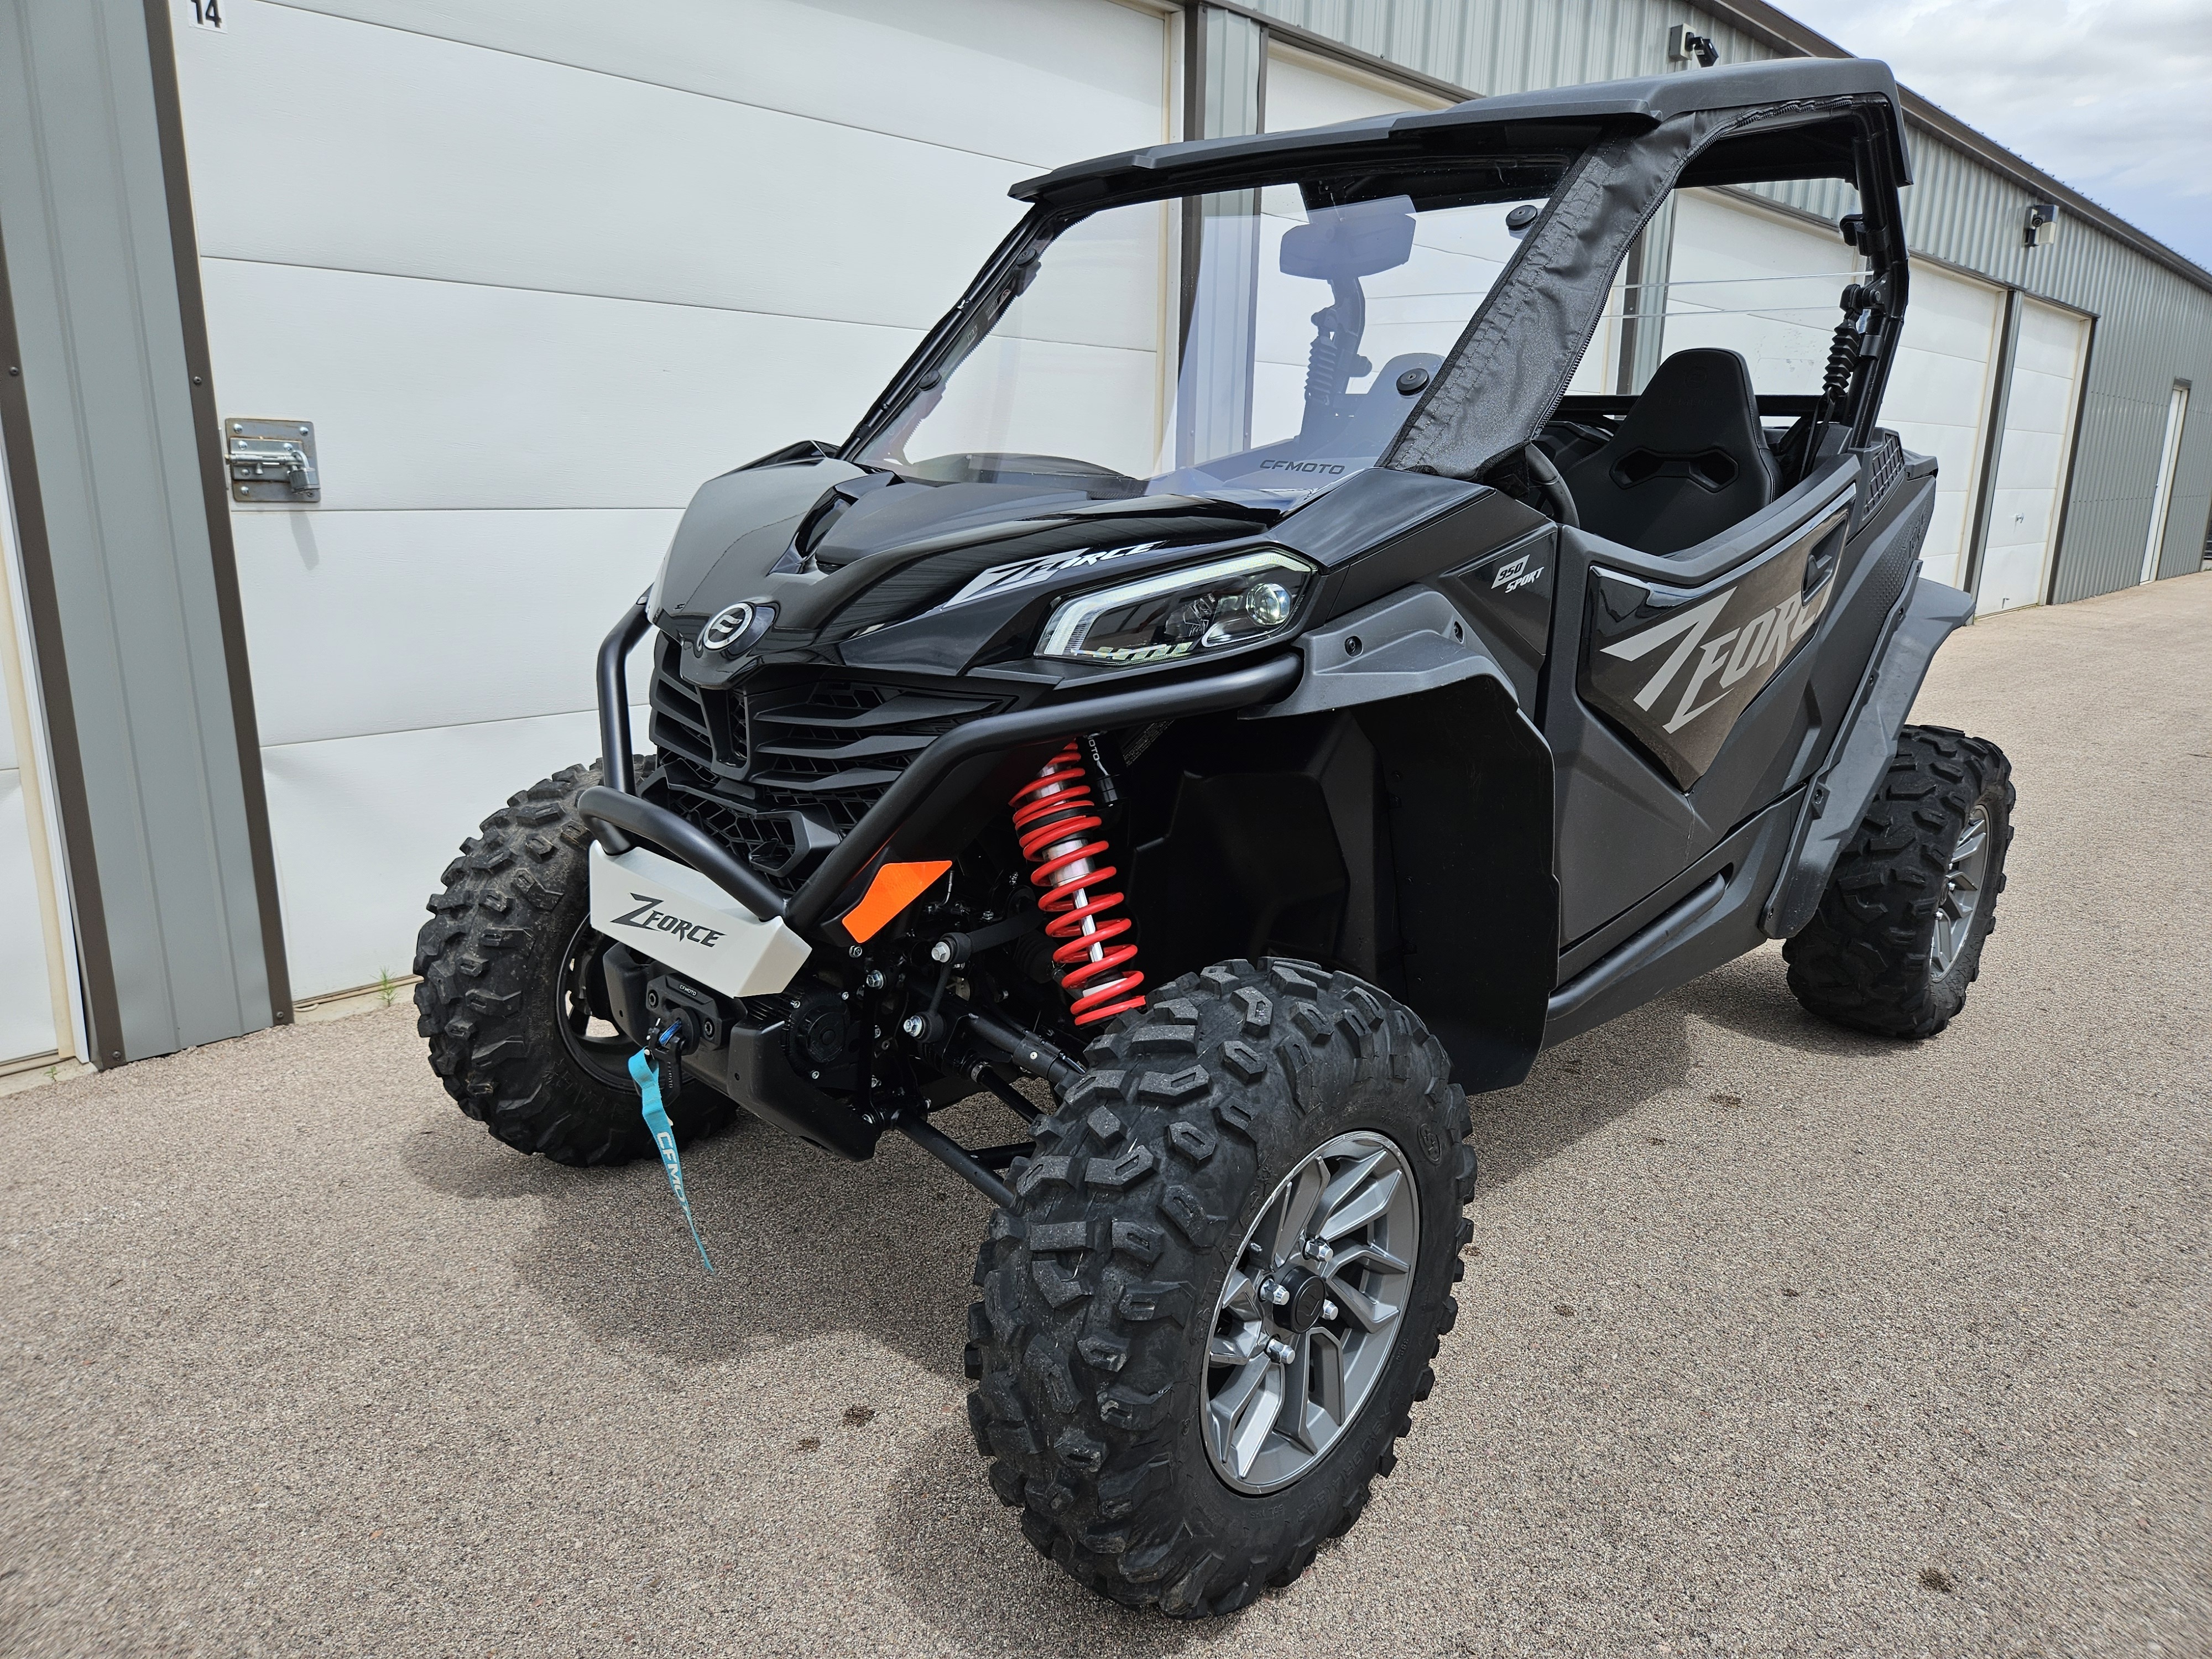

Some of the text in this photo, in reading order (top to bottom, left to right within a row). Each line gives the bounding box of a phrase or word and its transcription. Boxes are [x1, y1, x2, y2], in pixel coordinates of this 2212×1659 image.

[191, 0, 222, 28] 14
[1259, 460, 1345, 474] CFMOTO
[1498, 562, 1524, 581] 950
[1505, 566, 1545, 593] SPORT
[609, 893, 727, 948] ZFORCE
[680, 984, 697, 996] CFMOTO
